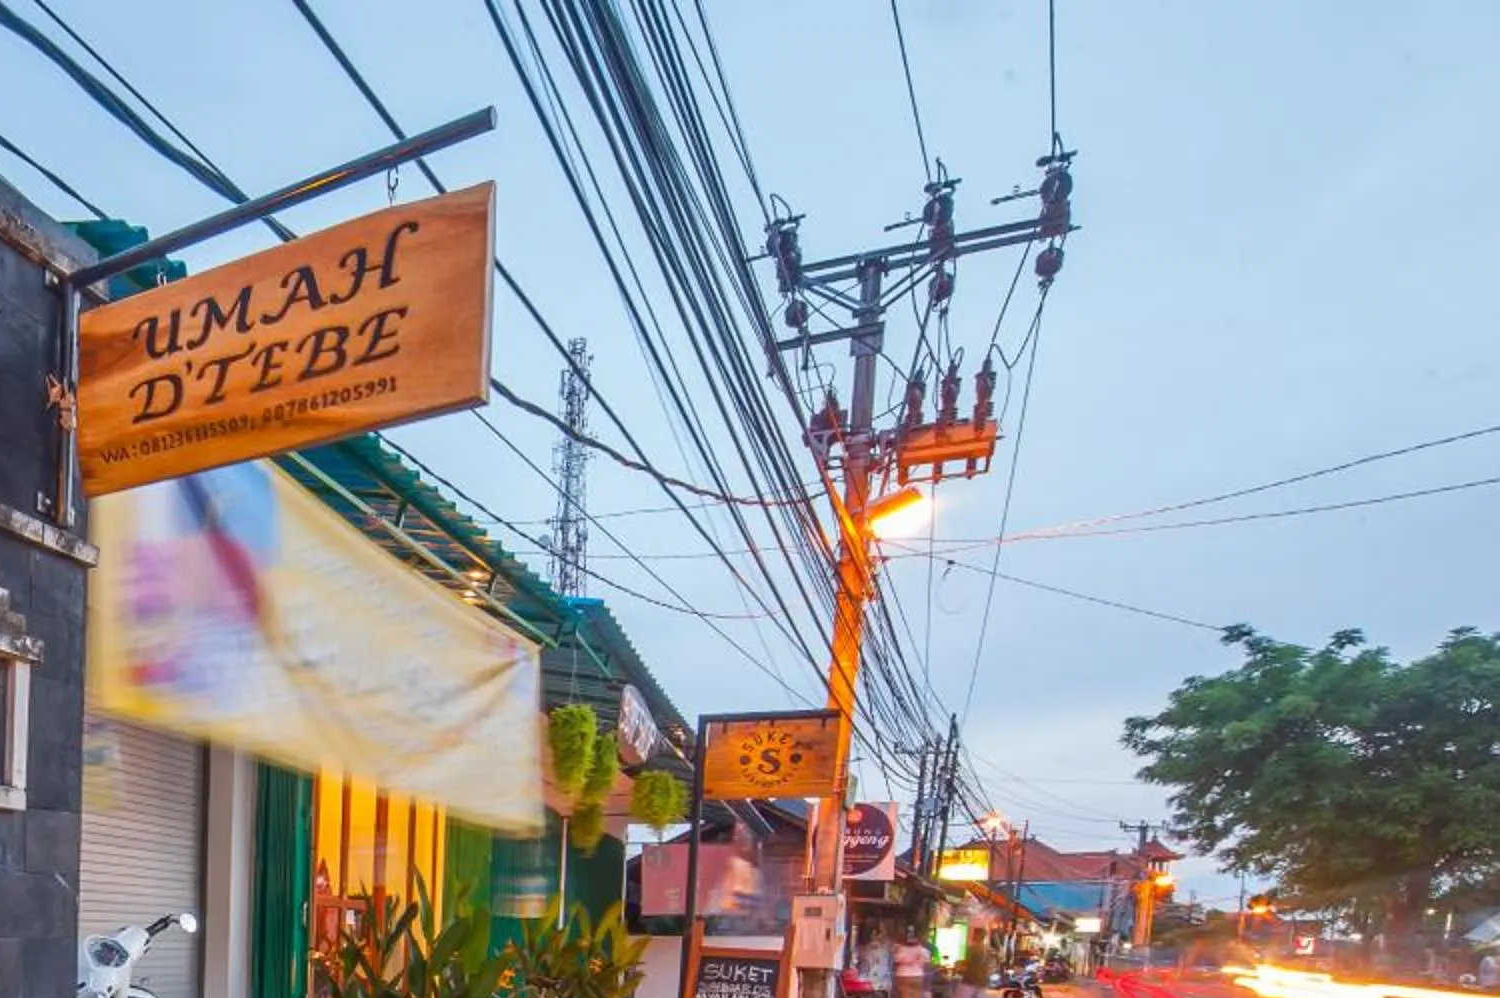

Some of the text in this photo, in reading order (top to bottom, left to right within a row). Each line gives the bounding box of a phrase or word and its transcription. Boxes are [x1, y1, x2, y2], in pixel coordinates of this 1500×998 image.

[132, 221, 419, 359] UMAH
[129, 306, 409, 424] D'TEBE
[758, 748, 781, 774] S
[704, 963, 773, 983] SUKET
